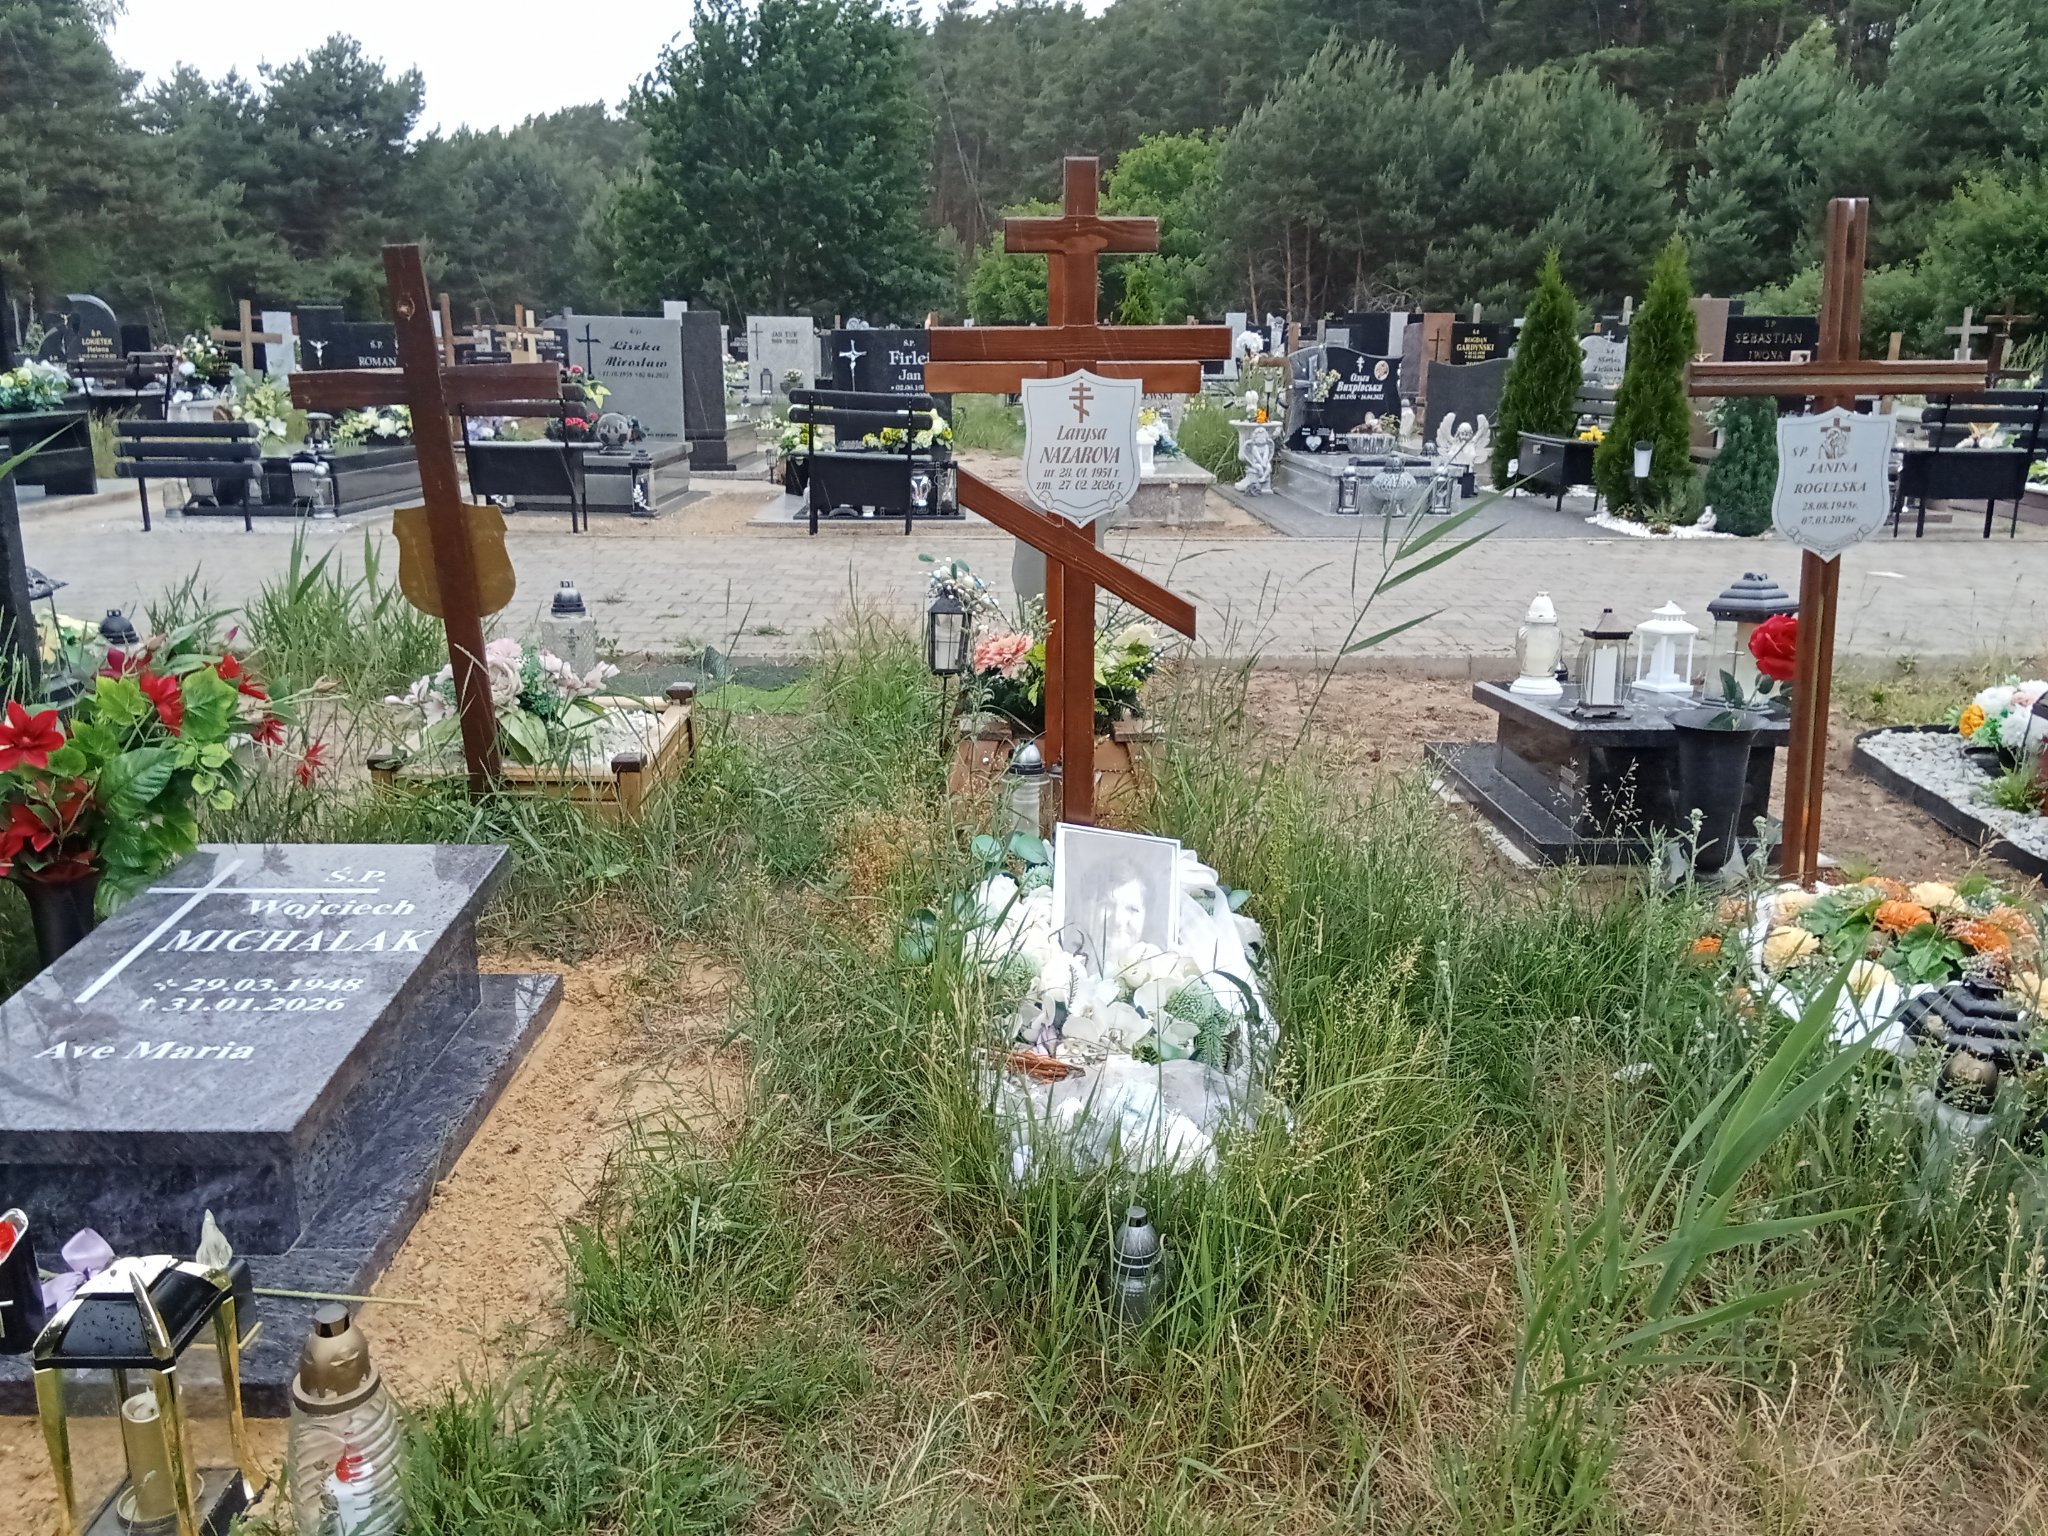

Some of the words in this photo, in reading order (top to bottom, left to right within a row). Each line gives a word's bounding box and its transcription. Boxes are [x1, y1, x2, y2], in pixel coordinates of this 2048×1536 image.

[1734, 332, 1802, 343] SEBASTIAN
[609, 341, 660, 351] Liszka
[358, 356, 397, 366] ROMAN
[898, 369, 921, 380] Jan
[1056, 424, 1107, 442] Larysa
[1039, 446, 1120, 463] NAZAROVA
[1807, 462, 1857, 473] JANINA
[1793, 482, 1866, 493] ROGULSKA
[246, 899, 416, 919] Wojciech
[158, 929, 434, 952] MICHALAK
[180, 978, 364, 992] 29.03.1948
[161, 997, 347, 1012] 31.01.2026
[32, 1040, 116, 1060] Ave
[123, 1041, 256, 1060] Maria
